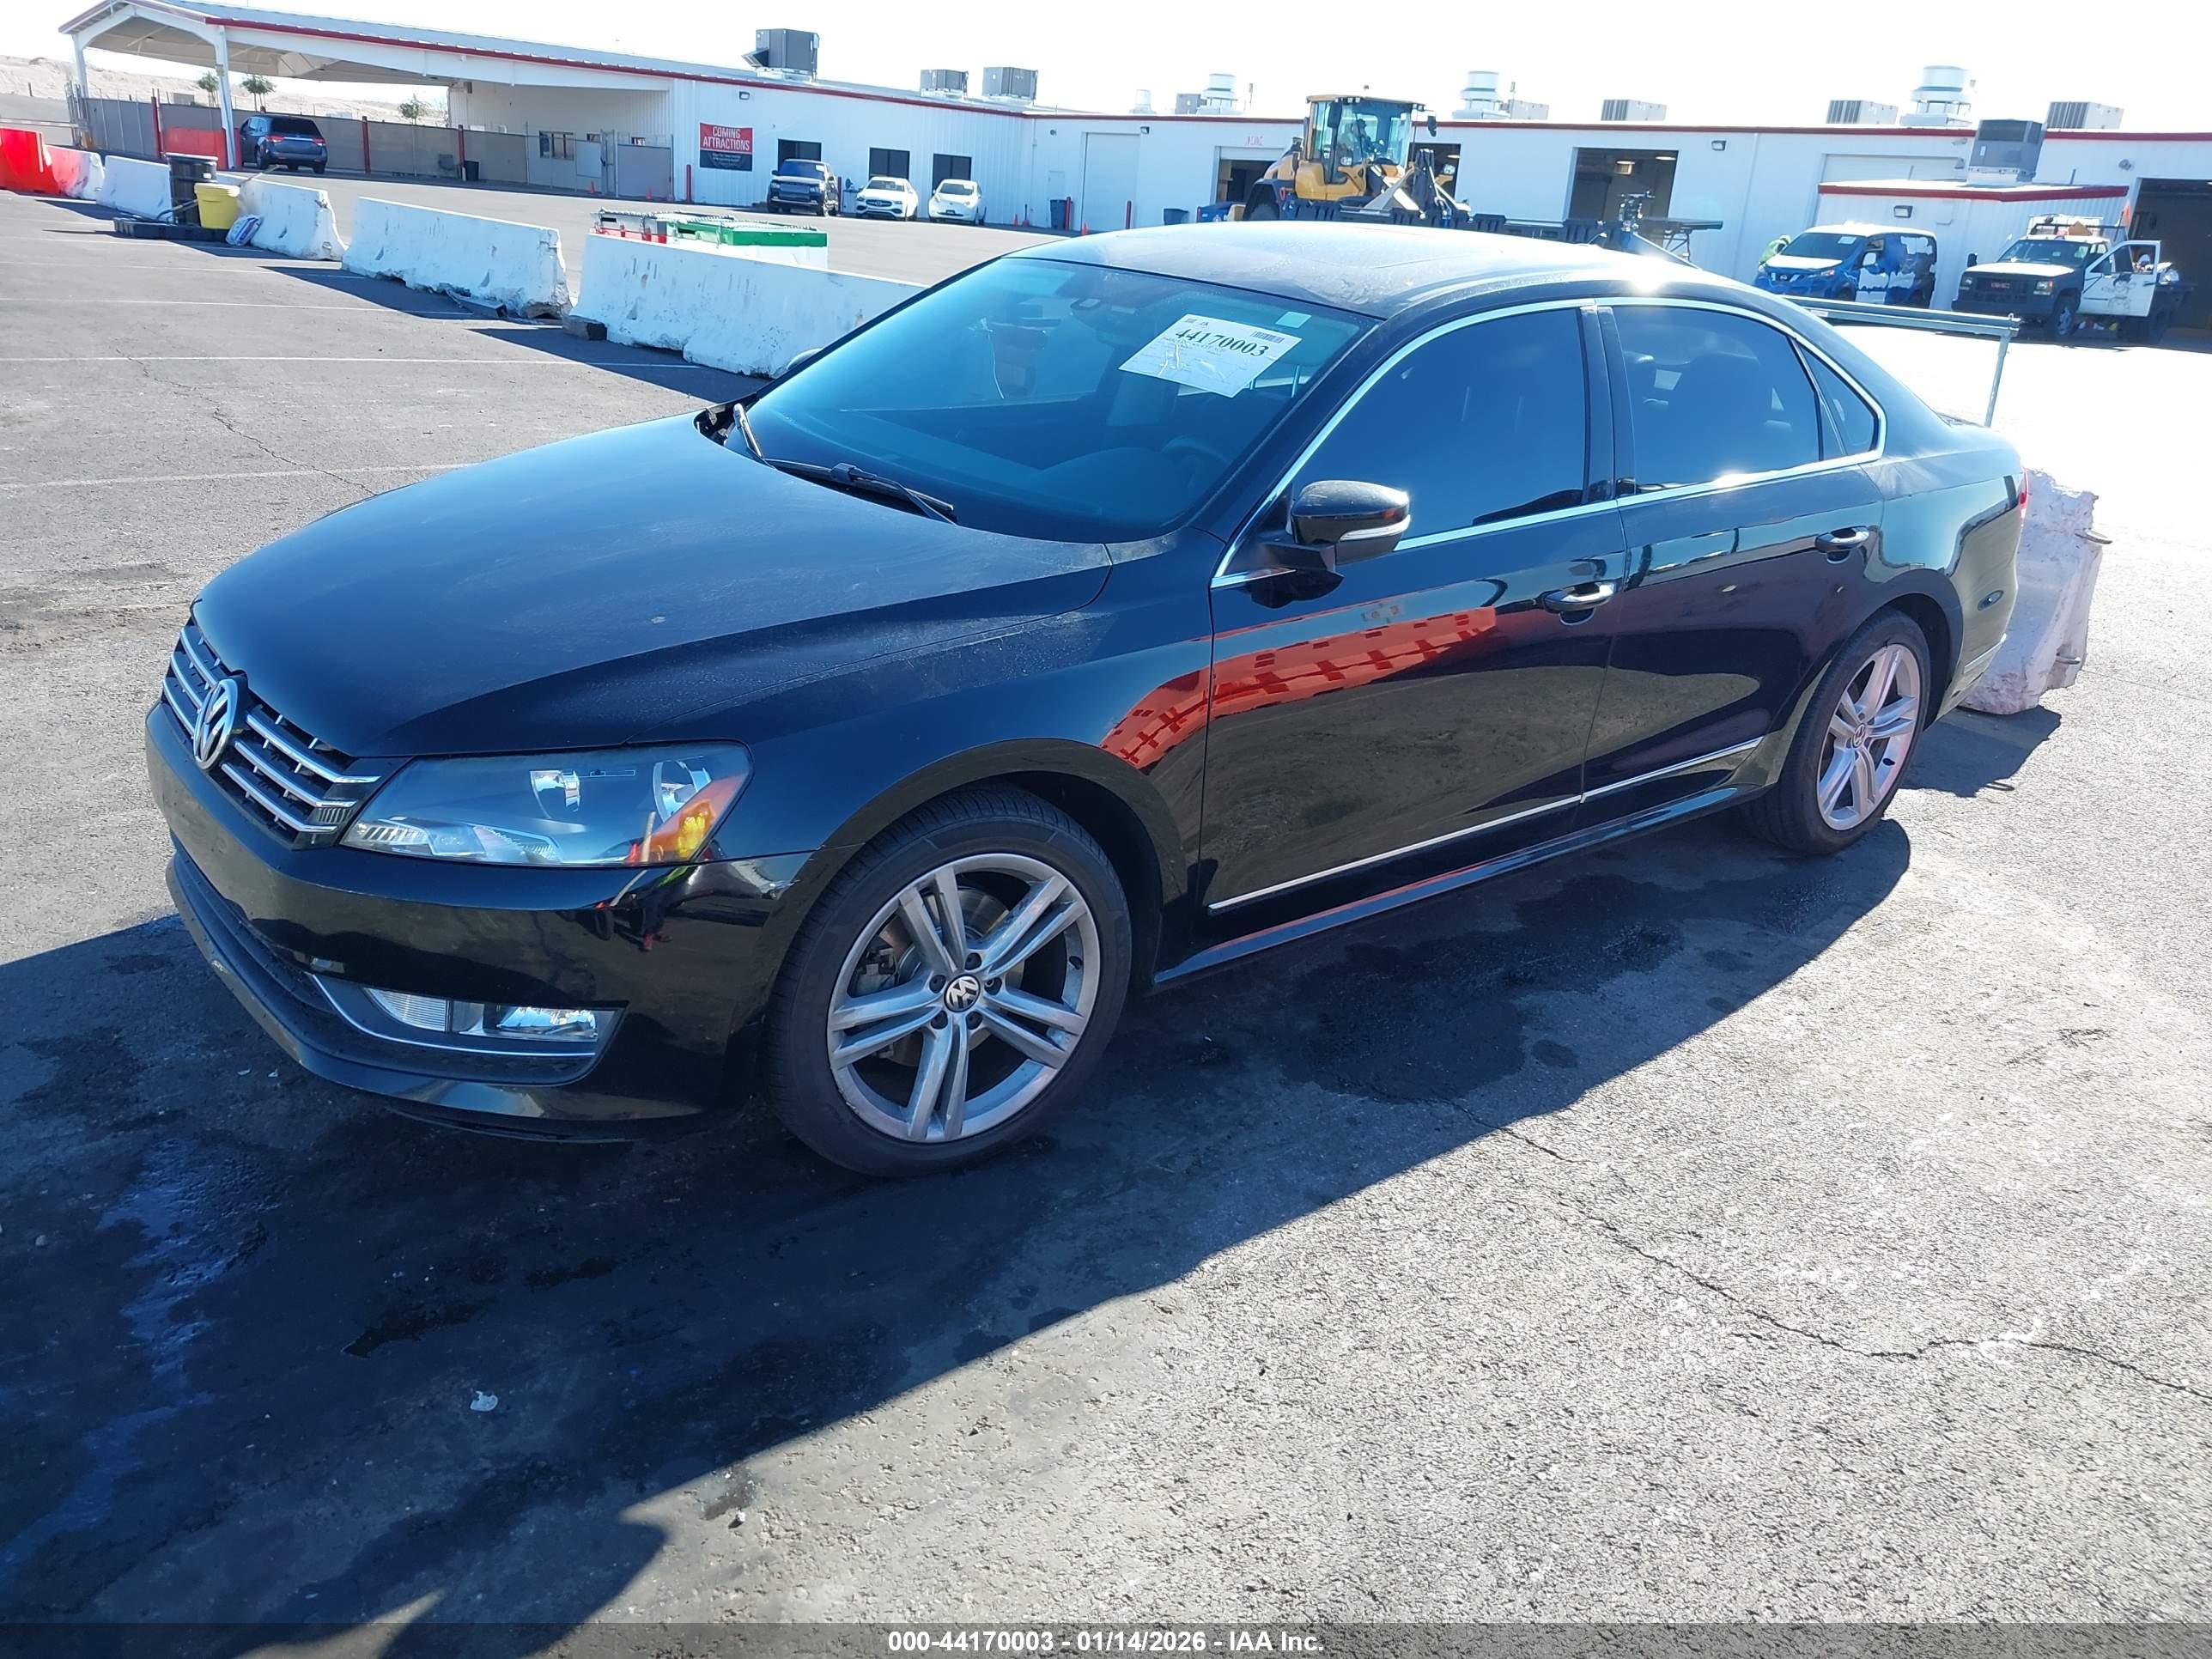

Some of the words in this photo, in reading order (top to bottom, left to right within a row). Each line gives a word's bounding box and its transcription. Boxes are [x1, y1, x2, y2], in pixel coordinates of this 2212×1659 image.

[713, 126, 740, 137] COMING
[703, 137, 750, 151] ATTRACTIONS
[1176, 329, 1269, 356] 44170003
